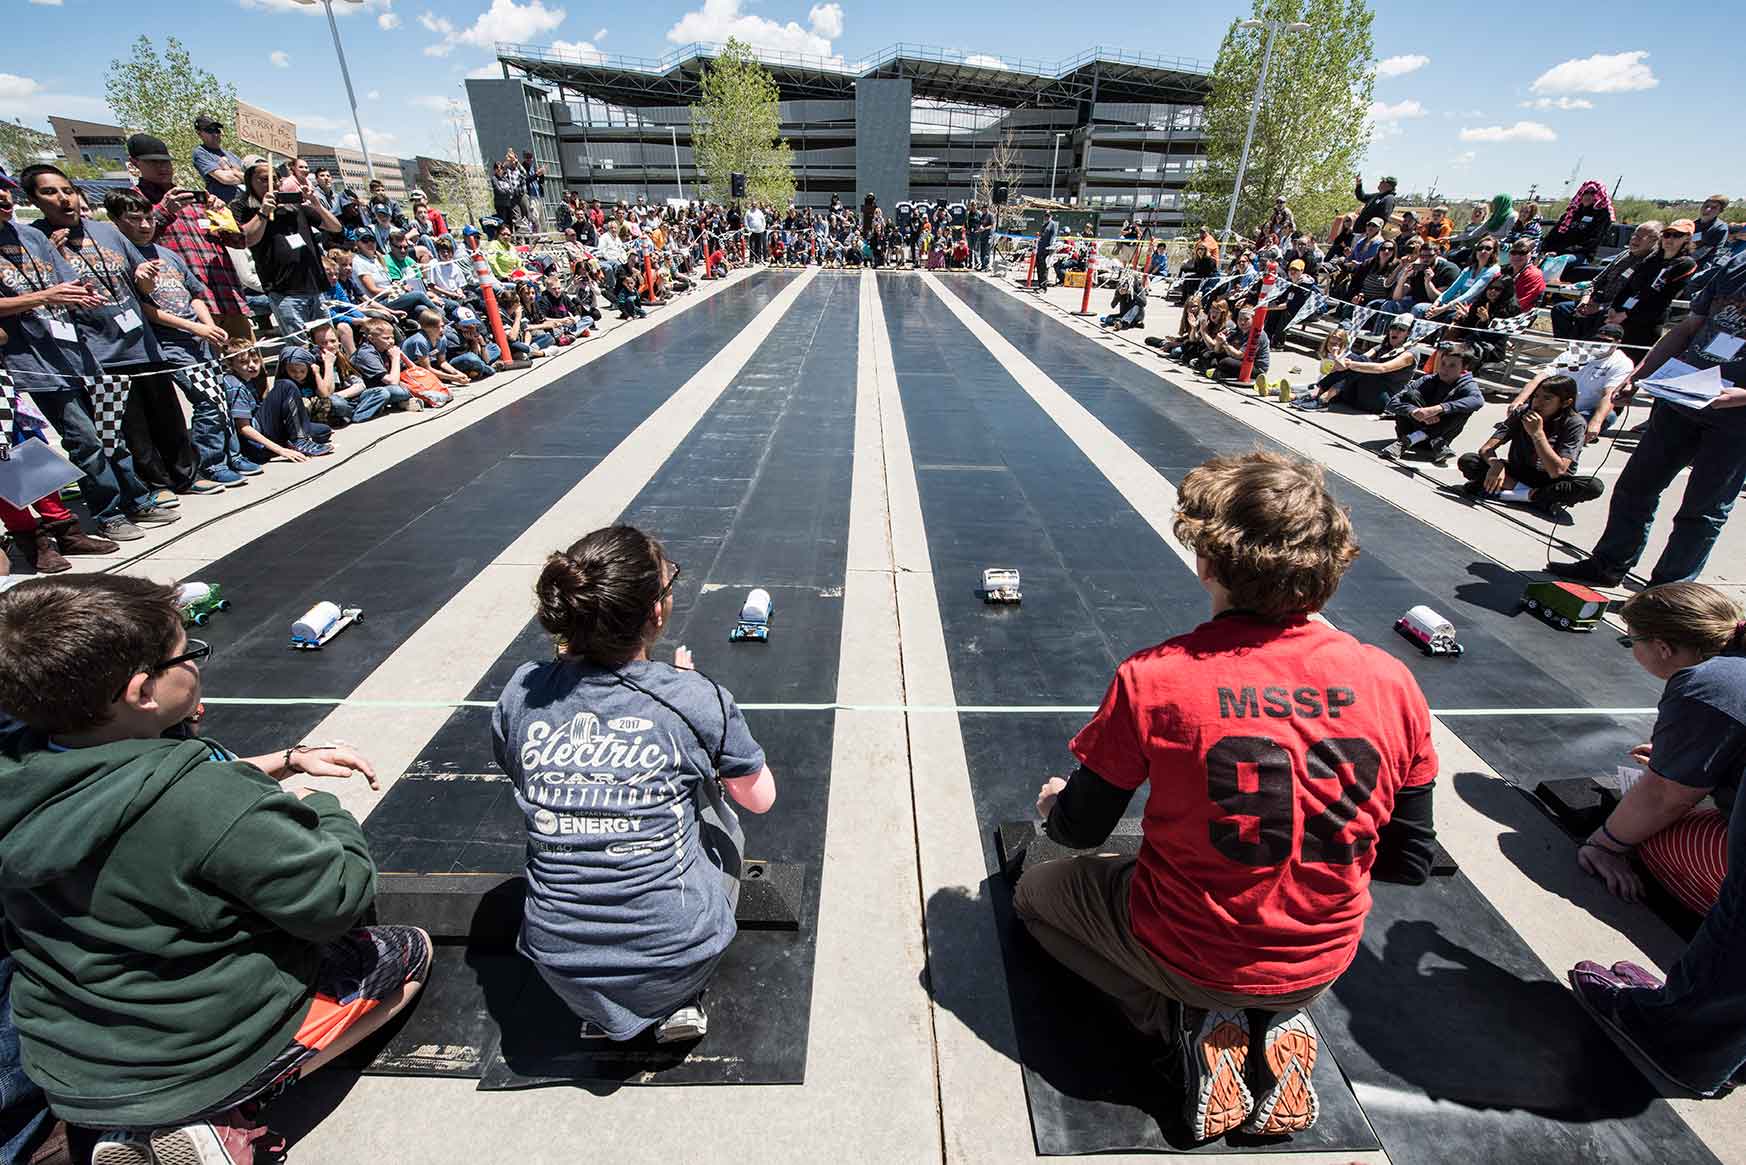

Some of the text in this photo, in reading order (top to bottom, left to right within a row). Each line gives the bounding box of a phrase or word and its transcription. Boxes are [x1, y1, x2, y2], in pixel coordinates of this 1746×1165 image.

[1217, 686, 1356, 719] MSSP
[619, 719, 641, 729] 2017
[521, 720, 668, 770] Electric
[543, 772, 619, 785] CAR
[527, 785, 668, 807] OMPETITIONS
[1206, 735, 1382, 866] 92
[559, 817, 642, 834] ENERGY
